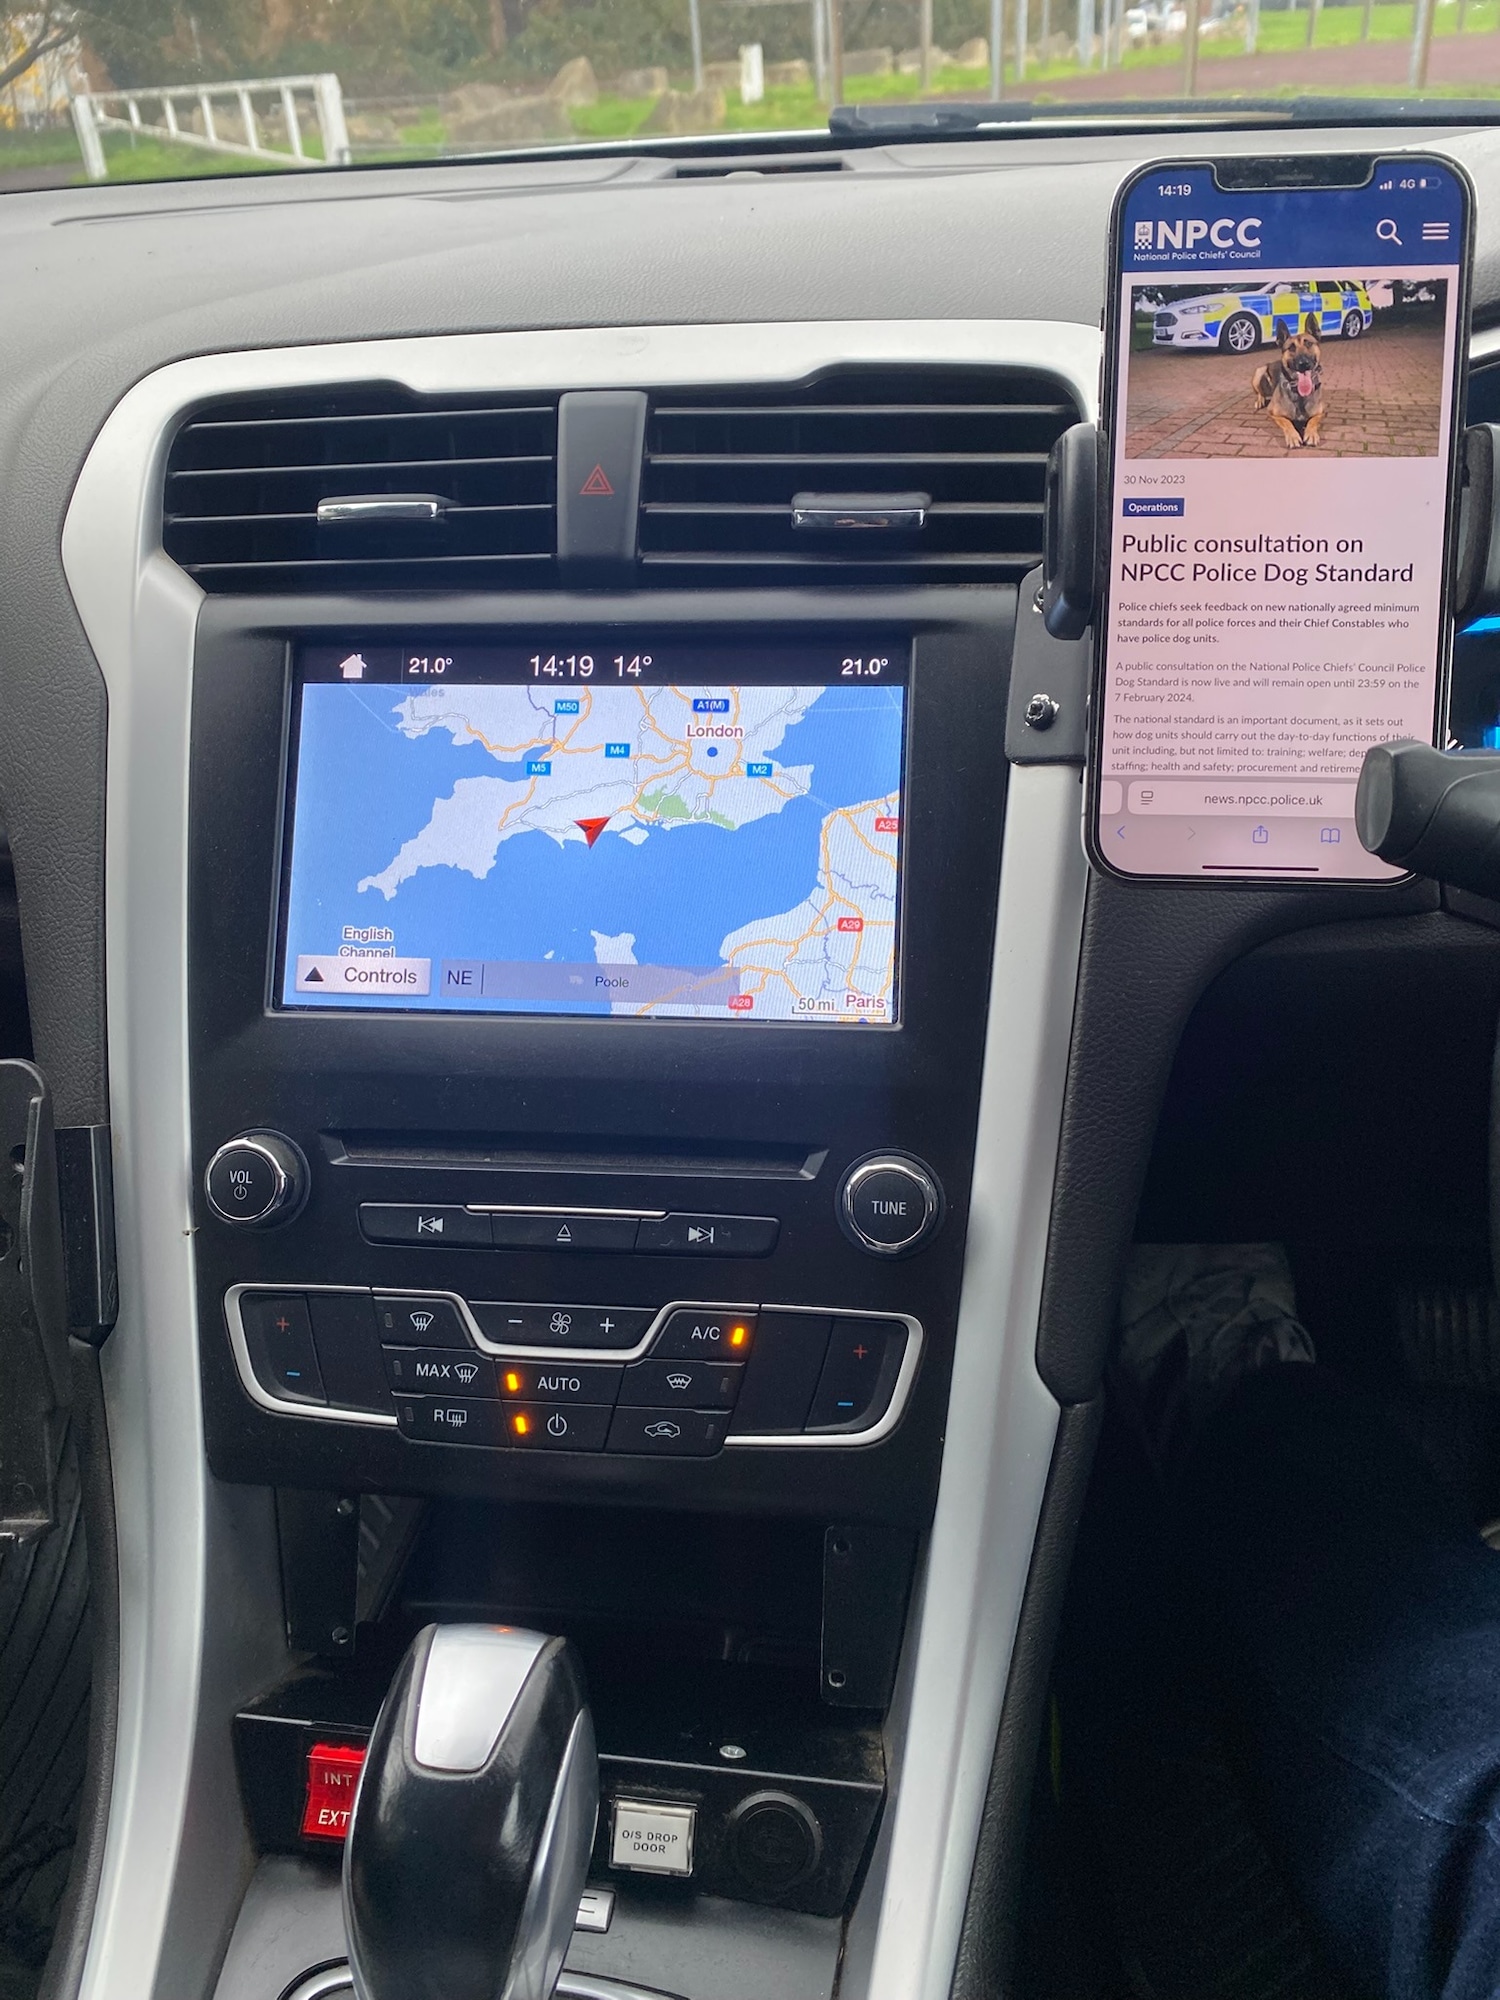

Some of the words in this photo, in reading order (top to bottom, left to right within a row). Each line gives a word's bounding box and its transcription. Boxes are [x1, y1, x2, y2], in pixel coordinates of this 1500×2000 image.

[1399, 178, 1416, 189] 4G
[1158, 184, 1192, 197] 14:19
[1156, 217, 1262, 249] NPCC
[1133, 252, 1170, 261] National
[1171, 251, 1197, 261] Police
[1229, 250, 1261, 259] Council
[1123, 475, 1137, 485] 30
[1139, 475, 1158, 485] Nov
[1160, 474, 1185, 484] 2023
[1128, 502, 1179, 514] Operations
[1122, 534, 1187, 554] Public
[1194, 534, 1329, 554] consultation
[1336, 538, 1364, 553] on
[1121, 563, 1185, 582] NPCC
[1192, 563, 1256, 582] Police
[1264, 564, 1309, 586] Dog
[1315, 563, 1414, 582] Standard
[1118, 602, 1147, 612] Police
[1149, 602, 1177, 612] chiefs
[1179, 602, 1202, 612] seek
[1204, 602, 1248, 612] feedback
[1288, 602, 1336, 615] nationally
[1338, 602, 1371, 615] agreed
[1374, 603, 1420, 613] minimum
[1117, 618, 1164, 628] standards
[1166, 618, 1180, 628] for
[1182, 618, 1194, 628] all
[1195, 618, 1224, 630] police
[1226, 618, 1256, 628] forces
[1258, 618, 1277, 628] and
[1279, 618, 1301, 628] their
[1304, 618, 1330, 629] Chief
[1331, 618, 1385, 629] Constables
[1387, 618, 1410, 629] who
[1117, 633, 1140, 644] have
[1142, 633, 1170, 646] police
[1172, 634, 1191, 646] dog
[1193, 634, 1220, 644] units.
[409, 657, 453, 674] 21.0°
[530, 655, 594, 677] 14:19
[613, 656, 652, 677] 14°
[841, 659, 889, 675] 21.0°
[1115, 662, 1123, 672] A
[1125, 661, 1153, 674] public
[1155, 661, 1214, 672] consultation
[1216, 664, 1229, 672] on
[1231, 662, 1247, 672] the
[1249, 662, 1290, 672] National
[1292, 662, 1321, 673] Police
[1358, 663, 1395, 673] Council
[1397, 663, 1426, 674] Police
[1115, 677, 1135, 689] Dog
[1136, 677, 1179, 688] Standard
[1180, 678, 1189, 687] is
[1214, 677, 1231, 688] live
[1233, 677, 1251, 688] and
[1253, 678, 1270, 688] will
[1271, 678, 1304, 689] remain
[1306, 680, 1331, 690] open
[1333, 678, 1355, 689] until
[1358, 679, 1386, 689] 23:59
[1388, 681, 1401, 689] on
[1403, 678, 1419, 689] the
[1115, 693, 1120, 702] 7
[1123, 693, 1165, 705] February
[1167, 693, 1195, 703] 2024.
[556, 702, 578, 712] M50
[696, 700, 726, 712] A1(M)
[1113, 715, 1131, 724] The
[1133, 715, 1172, 725] national
[1173, 715, 1215, 725] standard
[1217, 715, 1225, 725] is
[1227, 717, 1239, 725] an
[1241, 715, 1288, 728] important
[1290, 716, 1340, 727] document,
[1355, 716, 1364, 726] it
[1365, 717, 1385, 727] sets
[1388, 717, 1403, 727] out
[686, 724, 743, 738] London
[1112, 730, 1133, 740] how
[1134, 730, 1153, 742] dog
[1155, 731, 1178, 741] units
[1180, 730, 1212, 741] should
[1214, 733, 1239, 743] carry
[1241, 731, 1257, 741] out
[1260, 731, 1275, 741] the
[1277, 731, 1330, 744] day-to-day
[1332, 731, 1377, 742] functions
[1379, 732, 1390, 742] of
[610, 745, 625, 755] M4
[1112, 746, 1130, 756] unit
[1132, 746, 1177, 758] including,
[1179, 746, 1196, 756] but
[1198, 747, 1215, 756] not
[1216, 746, 1250, 757] limited
[531, 763, 546, 773] M5
[752, 765, 767, 775] M2
[1151, 761, 1180, 772] health
[1182, 761, 1200, 772] and
[1236, 763, 1297, 774] procurement
[1300, 763, 1318, 773] and
[1320, 763, 1360, 774] retireme
[1204, 794, 1323, 807] news.npcc.police.uk
[841, 921, 860, 929] A29
[344, 927, 392, 942] English
[340, 946, 394, 958] Channel
[344, 967, 417, 984] Controls
[447, 970, 473, 985] NE
[595, 975, 629, 989] Poole
[799, 998, 815, 1011] 50
[818, 998, 835, 1011] mi
[846, 995, 885, 1008] Paris
[229, 1170, 253, 1186] VOL
[871, 1200, 907, 1216] TUNE
[690, 1326, 720, 1342] A/C
[416, 1363, 451, 1379] MAX
[537, 1376, 581, 1392] AUTO
[433, 1409, 444, 1424] R
[324, 1772, 353, 1787] INT
[318, 1808, 350, 1827] EXT
[622, 1830, 642, 1840] O/S
[647, 1832, 678, 1843] DROP
[633, 1842, 666, 1854] DOOR
